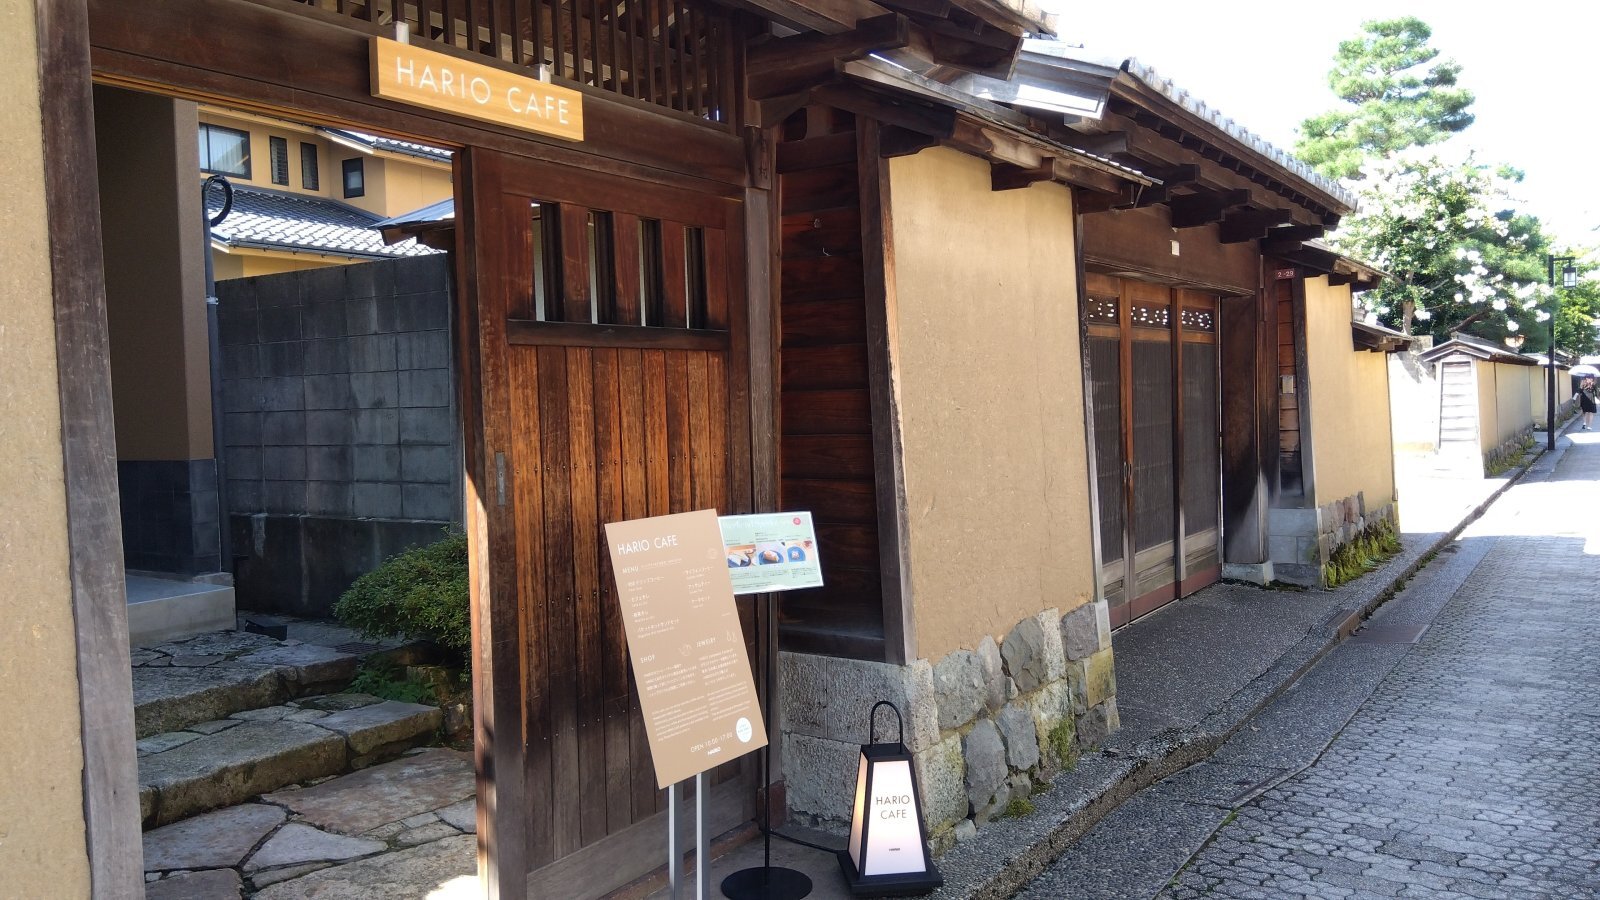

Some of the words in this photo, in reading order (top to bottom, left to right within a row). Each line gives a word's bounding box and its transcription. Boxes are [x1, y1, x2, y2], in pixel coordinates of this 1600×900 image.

[396, 56, 491, 105] HARIO
[506, 86, 569, 125] CAFE
[617, 539, 650, 556] HARIO
[654, 534, 679, 549] CAFE
[622, 566, 639, 574] MENU
[640, 654, 656, 664] SHOP
[691, 743, 705, 753] OPEN
[875, 794, 911, 806] HARIO
[880, 809, 907, 820] CAFE
